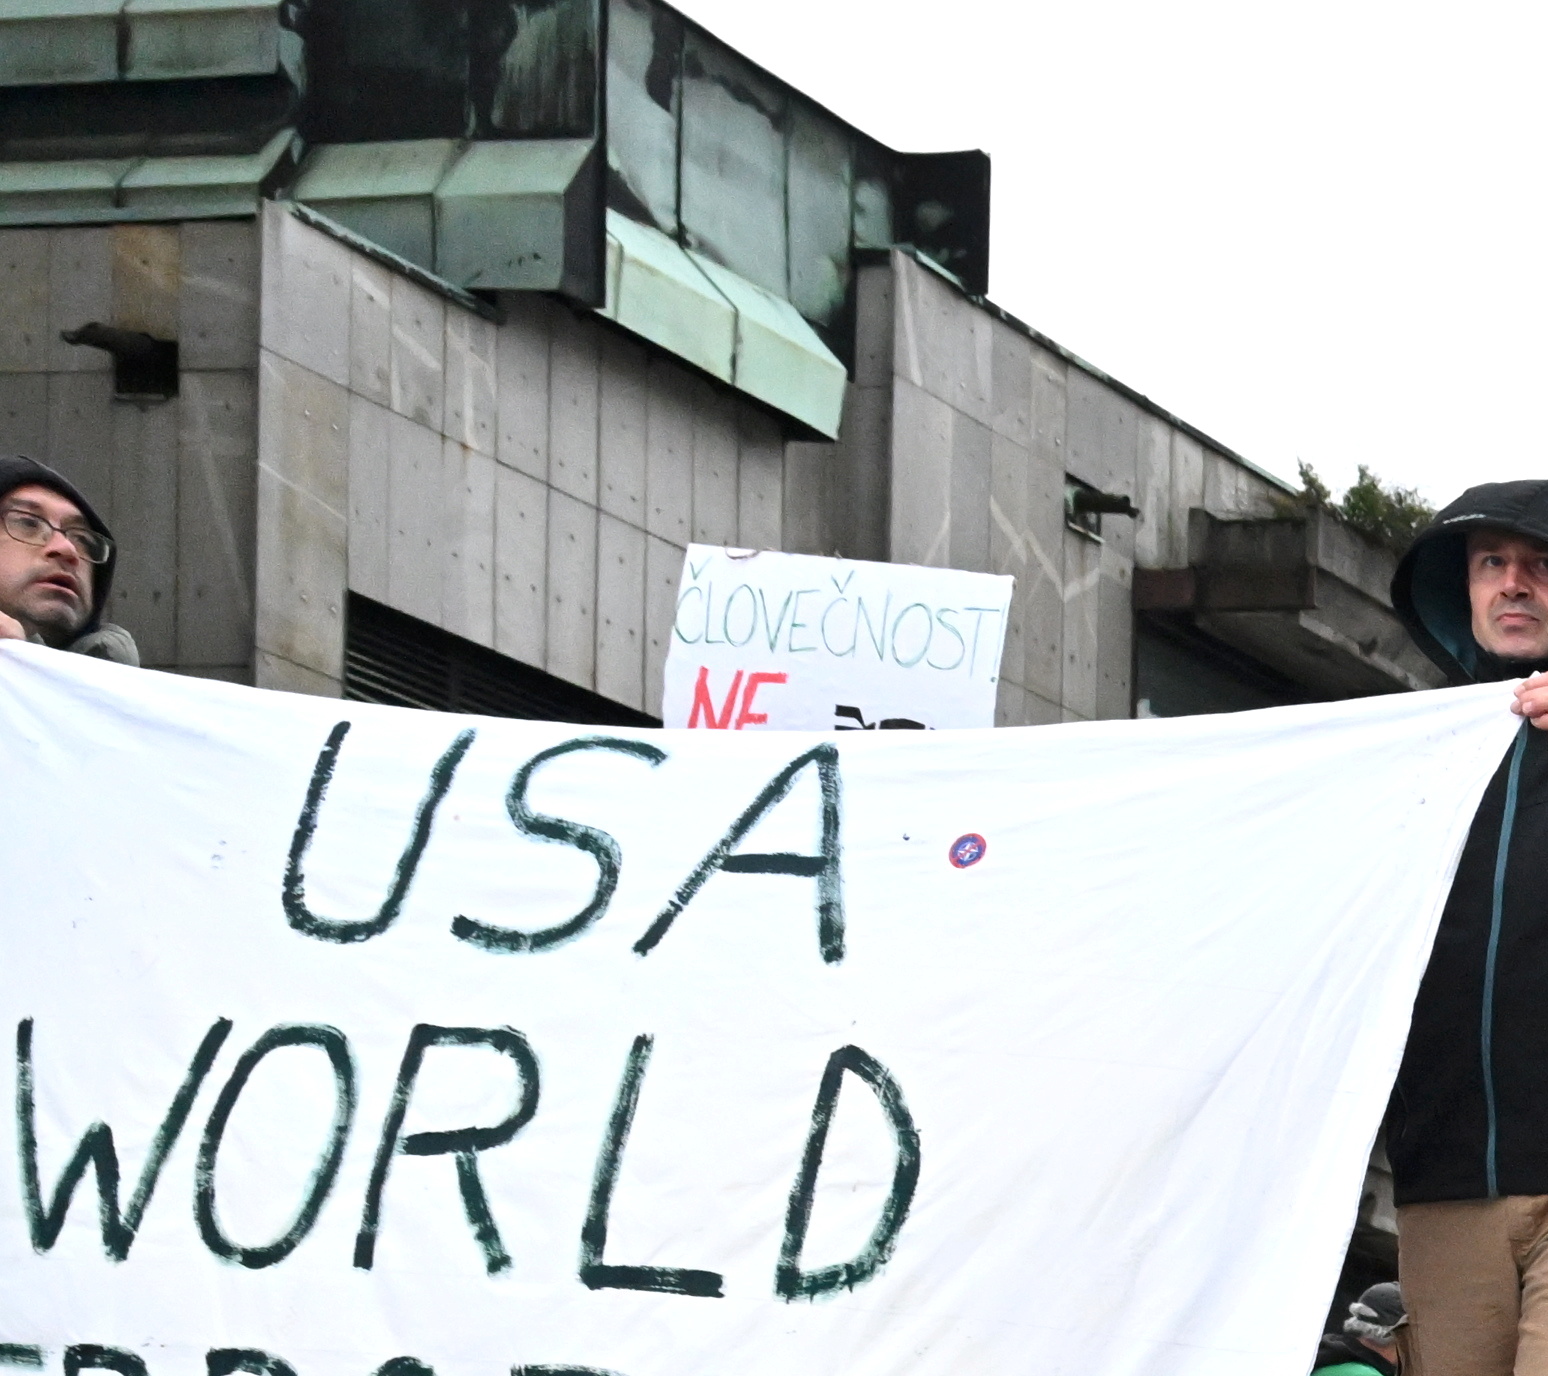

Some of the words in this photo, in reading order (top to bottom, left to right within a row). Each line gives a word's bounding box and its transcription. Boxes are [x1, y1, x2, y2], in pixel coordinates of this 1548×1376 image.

[674, 556, 1009, 683] ČLOVEČNOST!
[281, 720, 844, 964] USA
[16, 1016, 921, 1303] WORLD
